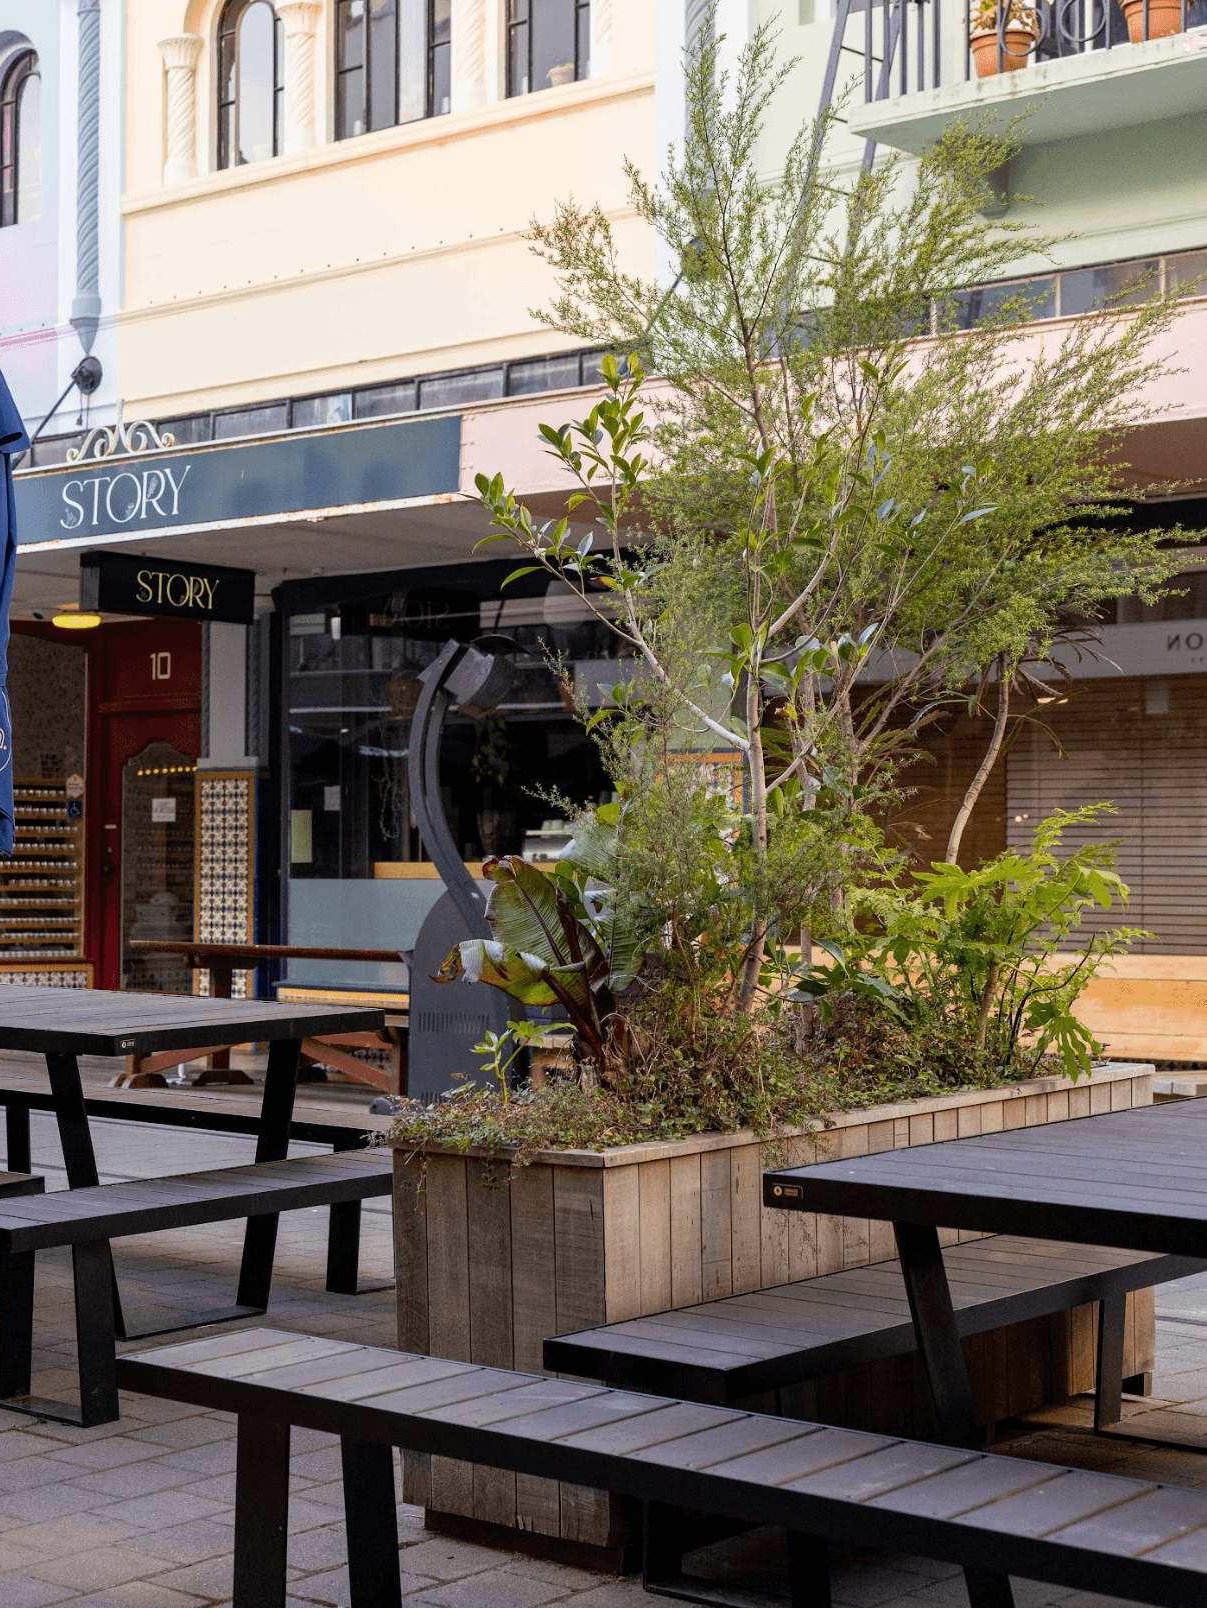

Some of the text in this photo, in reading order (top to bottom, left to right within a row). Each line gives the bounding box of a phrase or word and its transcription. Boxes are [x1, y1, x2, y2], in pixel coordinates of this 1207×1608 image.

[60, 465, 191, 529] STORY
[136, 570, 220, 609] STORY
[150, 652, 171, 680] 10
